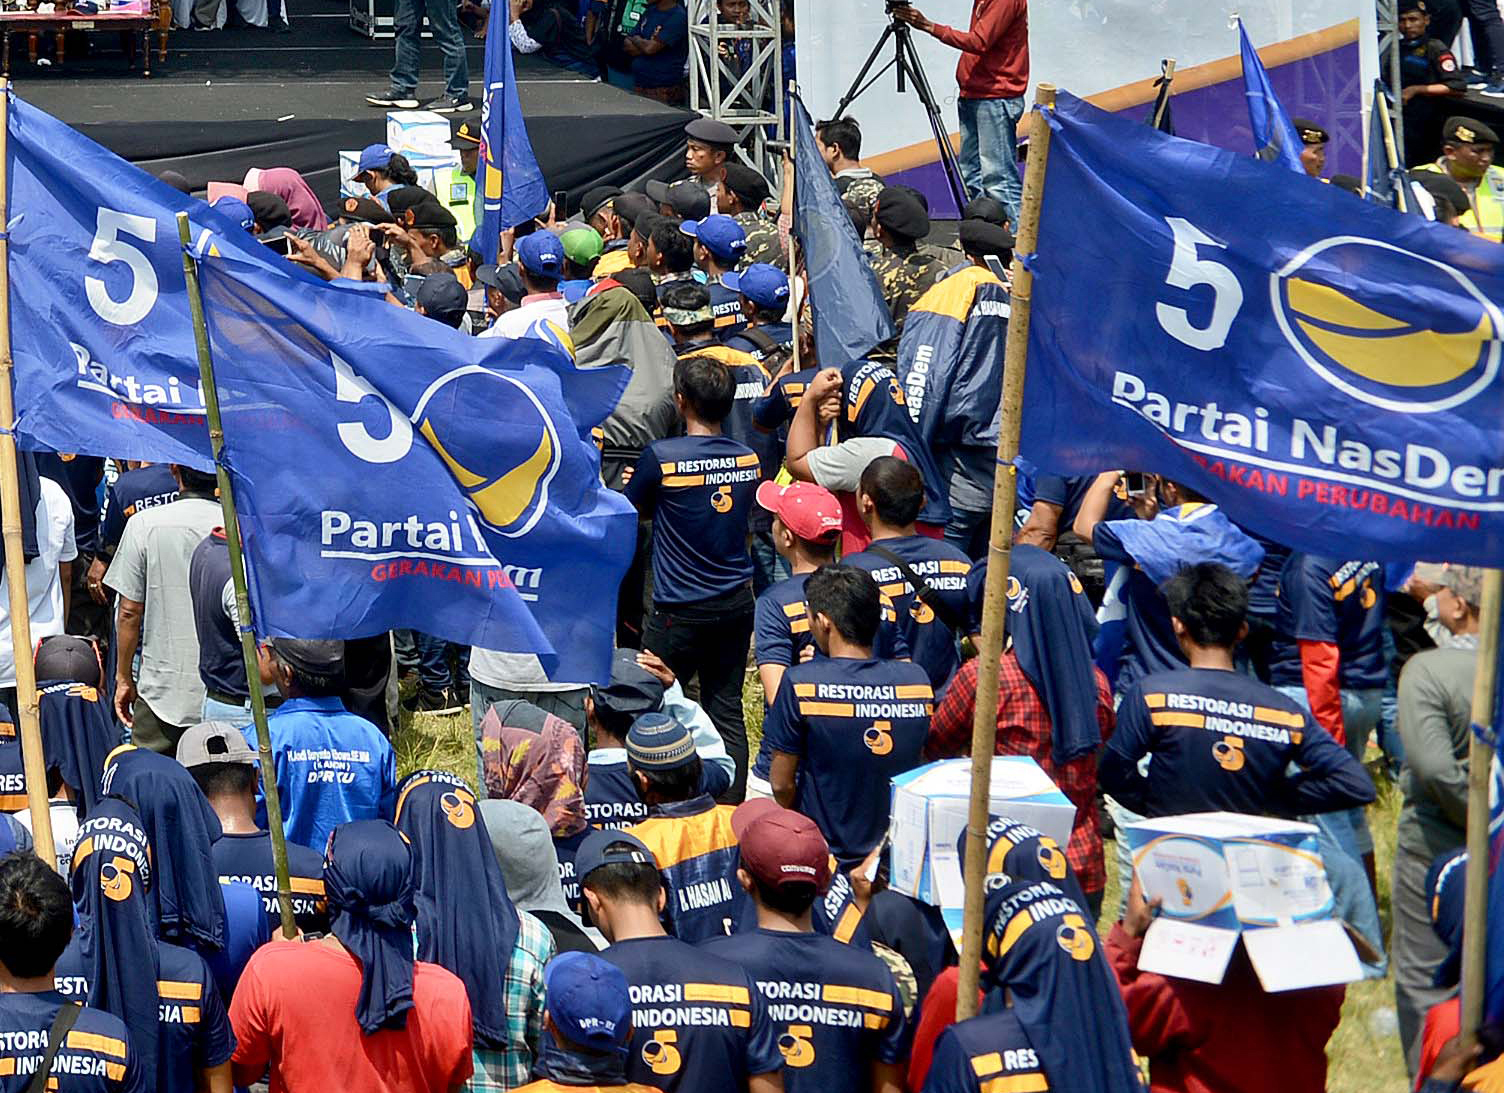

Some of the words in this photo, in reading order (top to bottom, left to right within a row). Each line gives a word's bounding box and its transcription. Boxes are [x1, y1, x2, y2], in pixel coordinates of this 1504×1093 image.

[85, 207, 158, 325] 5
[1155, 216, 1244, 351] 5
[713, 301, 741, 316] RESTO
[70, 342, 180, 405] Partai
[1112, 371, 1269, 452] Partai
[678, 458, 736, 473] RESTORASI
[705, 471, 757, 485] INDONESIA
[135, 492, 179, 512] RESTO
[1297, 480, 1480, 530] PERUBAHAN
[321, 510, 462, 552] Partai
[371, 561, 481, 587] GERAKAN
[872, 561, 940, 581] RESTRASI
[818, 683, 895, 700] RESTORASI
[855, 702, 926, 719] INDONESIA
[1167, 693, 1253, 719] RESTORASI
[1205, 716, 1290, 744] INDONESIA
[584, 803, 648, 819] STORASI
[77, 817, 147, 848] STORASI
[629, 983, 681, 1004] ORASI
[757, 981, 820, 1001] TORASI
